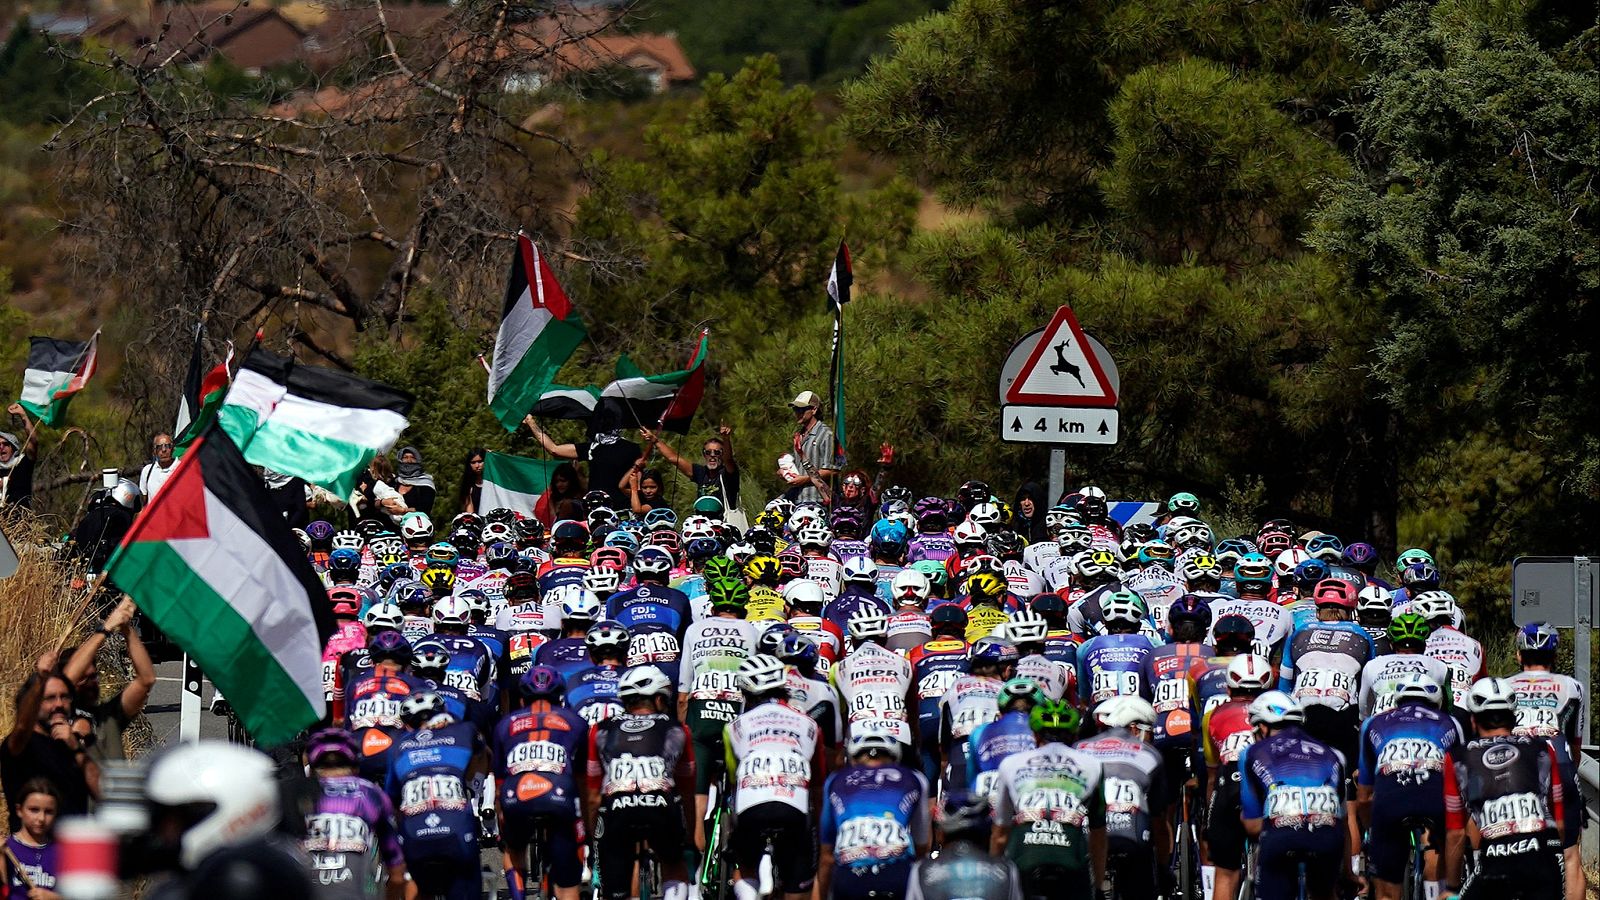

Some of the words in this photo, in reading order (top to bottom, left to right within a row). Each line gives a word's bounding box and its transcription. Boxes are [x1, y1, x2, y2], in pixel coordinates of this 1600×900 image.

[1034, 417, 1047, 432] 4
[1058, 418, 1085, 433] km
[513, 603, 544, 614] UAE
[622, 597, 669, 608] Groupama
[631, 606, 650, 615] FDJ
[631, 612, 657, 621] UNITED
[1218, 604, 1280, 617] BAHRAIN
[701, 627, 742, 638] CAJA
[514, 636, 523, 652] 2
[652, 635, 678, 652] 138
[693, 637, 749, 652] RURAL
[1385, 660, 1425, 669] CAJA
[695, 672, 719, 690] 146
[723, 673, 740, 691] 14
[922, 673, 939, 691] 22
[1300, 671, 1317, 688] 83
[1332, 672, 1349, 690] 83
[1533, 684, 1561, 692] Bull
[1153, 682, 1181, 703] 191
[1516, 692, 1559, 700] ORA
[705, 701, 736, 714] CAJA
[850, 693, 874, 713] 182
[1536, 710, 1554, 725] 42
[611, 794, 668, 811] ARKEA
[1306, 791, 1337, 813] 225
[1486, 837, 1540, 858] ARKEA
